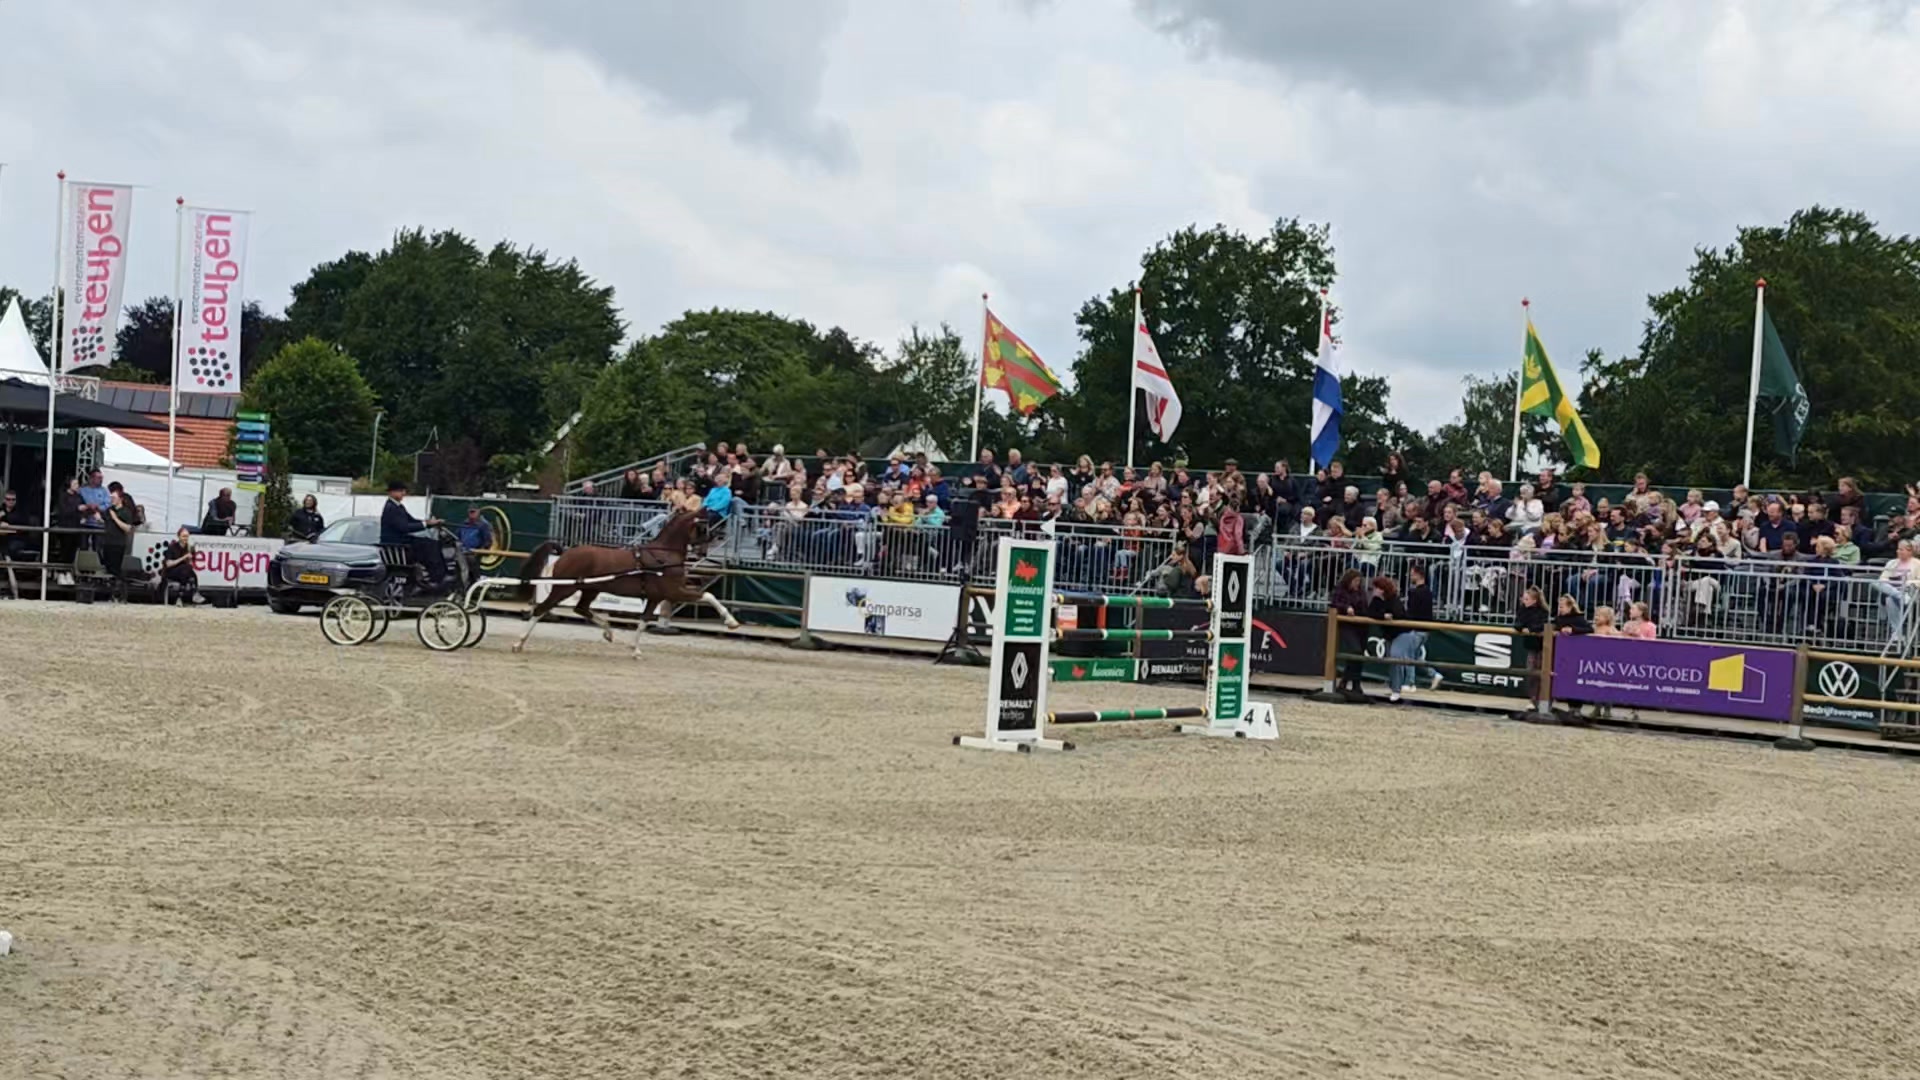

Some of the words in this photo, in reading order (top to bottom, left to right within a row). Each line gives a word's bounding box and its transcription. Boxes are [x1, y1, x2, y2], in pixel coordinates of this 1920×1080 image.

[82, 189, 122, 321] teuben
[201, 214, 239, 343] teuben
[191, 549, 271, 582] euben
[1151, 664, 1183, 675] RENAULT
[1461, 672, 1524, 688] SEAT
[1578, 659, 1615, 676] JANS
[1618, 663, 1703, 683] VASTGOED
[1244, 708, 1255, 725] 4
[1264, 709, 1272, 727] 4
